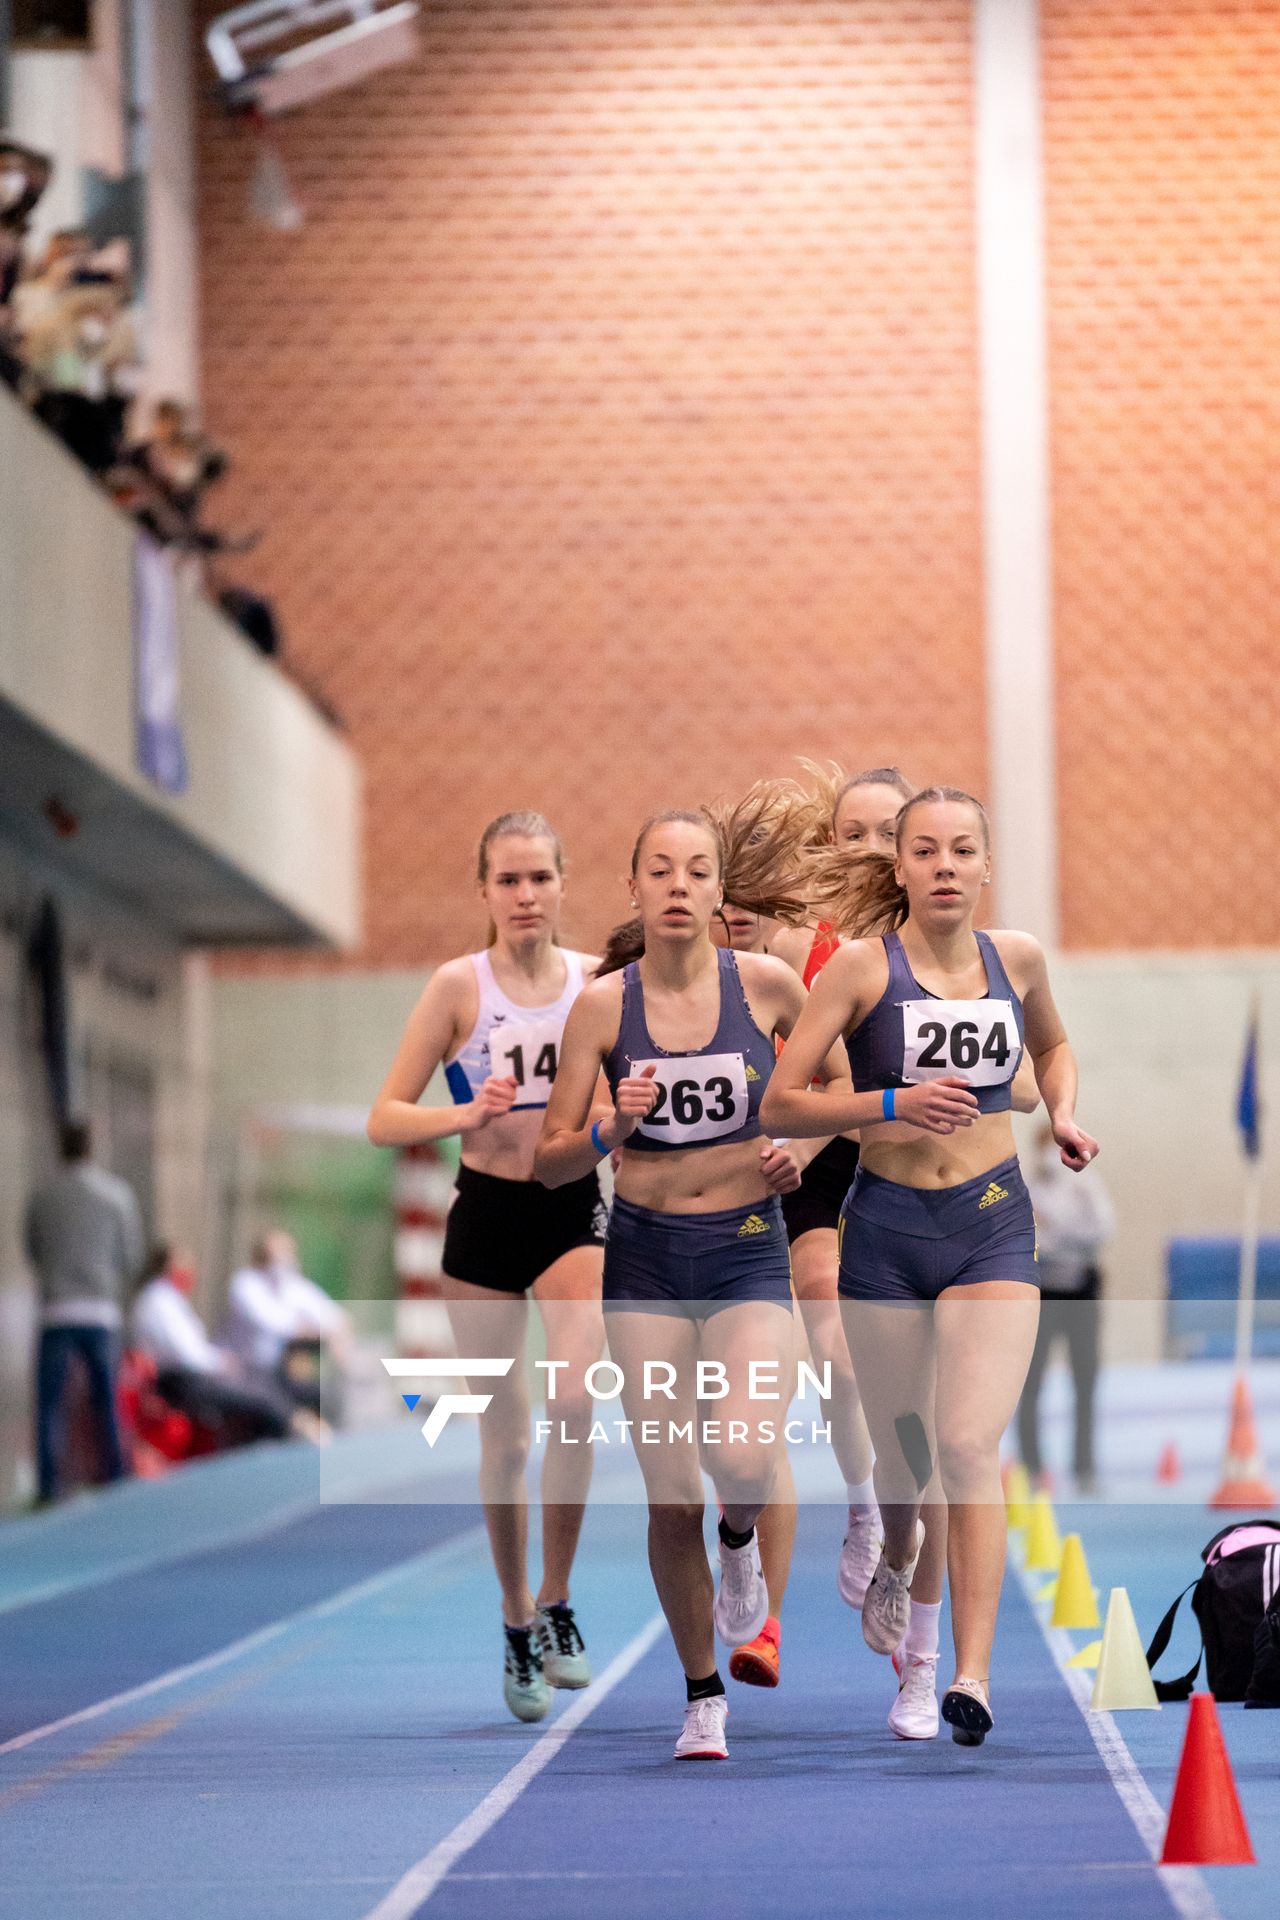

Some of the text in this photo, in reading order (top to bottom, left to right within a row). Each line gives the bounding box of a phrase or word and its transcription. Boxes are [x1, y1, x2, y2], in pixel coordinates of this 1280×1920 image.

[916, 1021, 1010, 1068] 264
[642, 1076, 736, 1126] 263
[979, 1189, 1009, 1210] adidas
[737, 1222, 770, 1238] adidas
